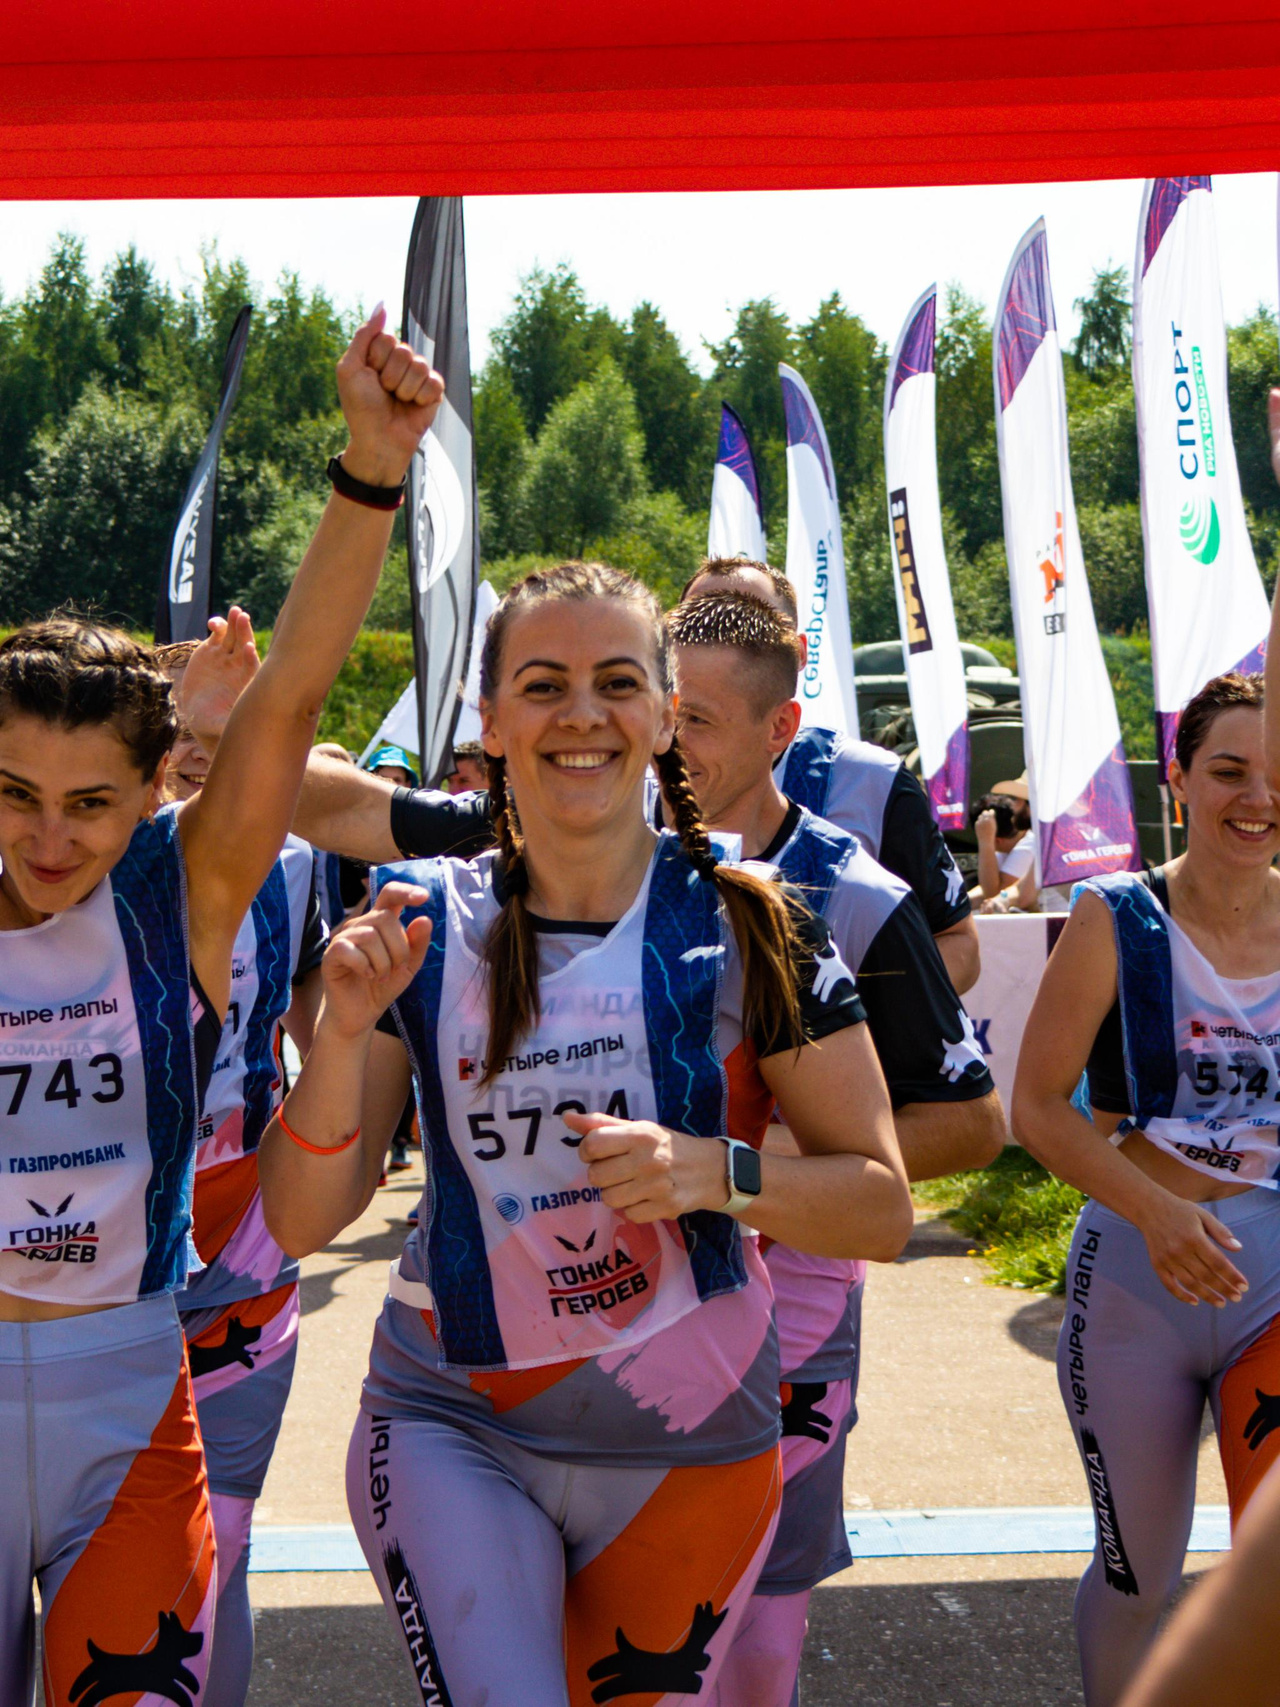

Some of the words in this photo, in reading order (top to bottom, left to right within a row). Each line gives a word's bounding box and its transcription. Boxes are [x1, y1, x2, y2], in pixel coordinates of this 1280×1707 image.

[1170, 320, 1199, 480] СПОРТ
[1192, 350, 1212, 434] НОВОСТИ
[1204, 437, 1216, 472] РИА
[60, 998, 119, 1021] лапы
[566, 1033, 624, 1062] лапы
[9, 1142, 126, 1174] ГАЗПРОМБАНК
[9, 1221, 96, 1246] ГОНКА
[545, 1248, 634, 1287] ГОНКА
[1073, 1228, 1102, 1310] лапы
[550, 1271, 649, 1318] ГЕРОЕВ
[1069, 1313, 1088, 1417] четыре
[1086, 1452, 1126, 1575] КОМАНДА
